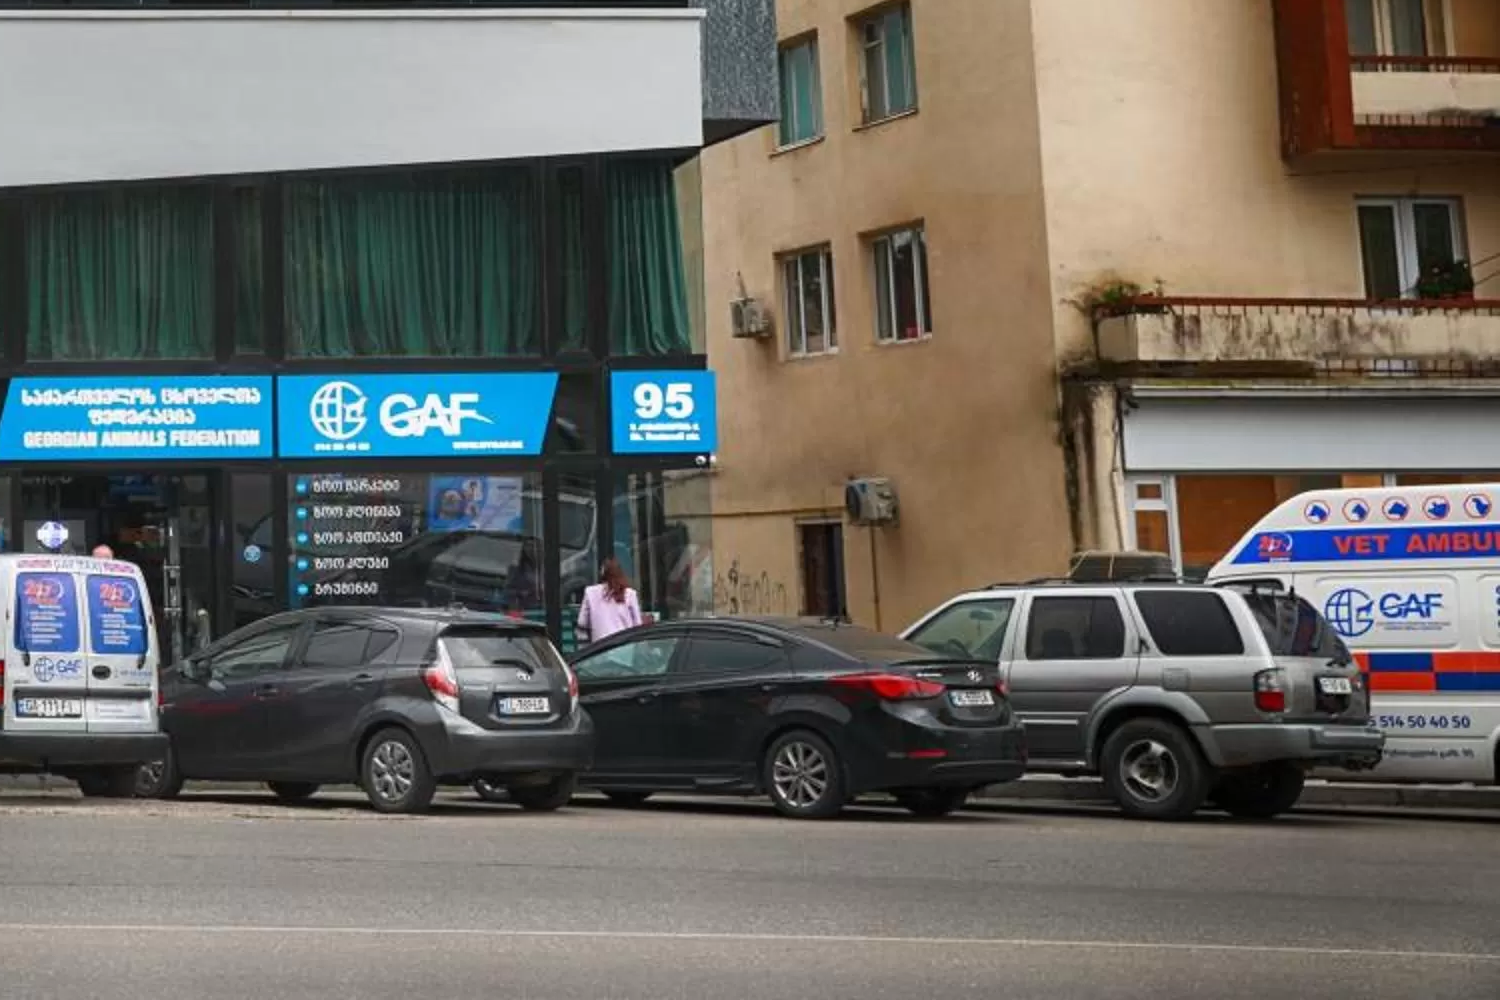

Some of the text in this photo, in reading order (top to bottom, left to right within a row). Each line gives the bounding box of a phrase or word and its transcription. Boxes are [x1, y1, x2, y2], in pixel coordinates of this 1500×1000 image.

[633, 383, 694, 419] 95
[379, 392, 480, 437] GAF
[23, 429, 261, 448] GEORGIAN ANIMALS FEDERATION
[1332, 535, 1390, 553] VET
[1379, 593, 1443, 618] GAF
[56, 659, 82, 673] GAF
[1380, 715, 1404, 728] 514
[1408, 715, 1426, 728] 50
[1430, 715, 1449, 728] 40
[1451, 715, 1471, 728] 50
